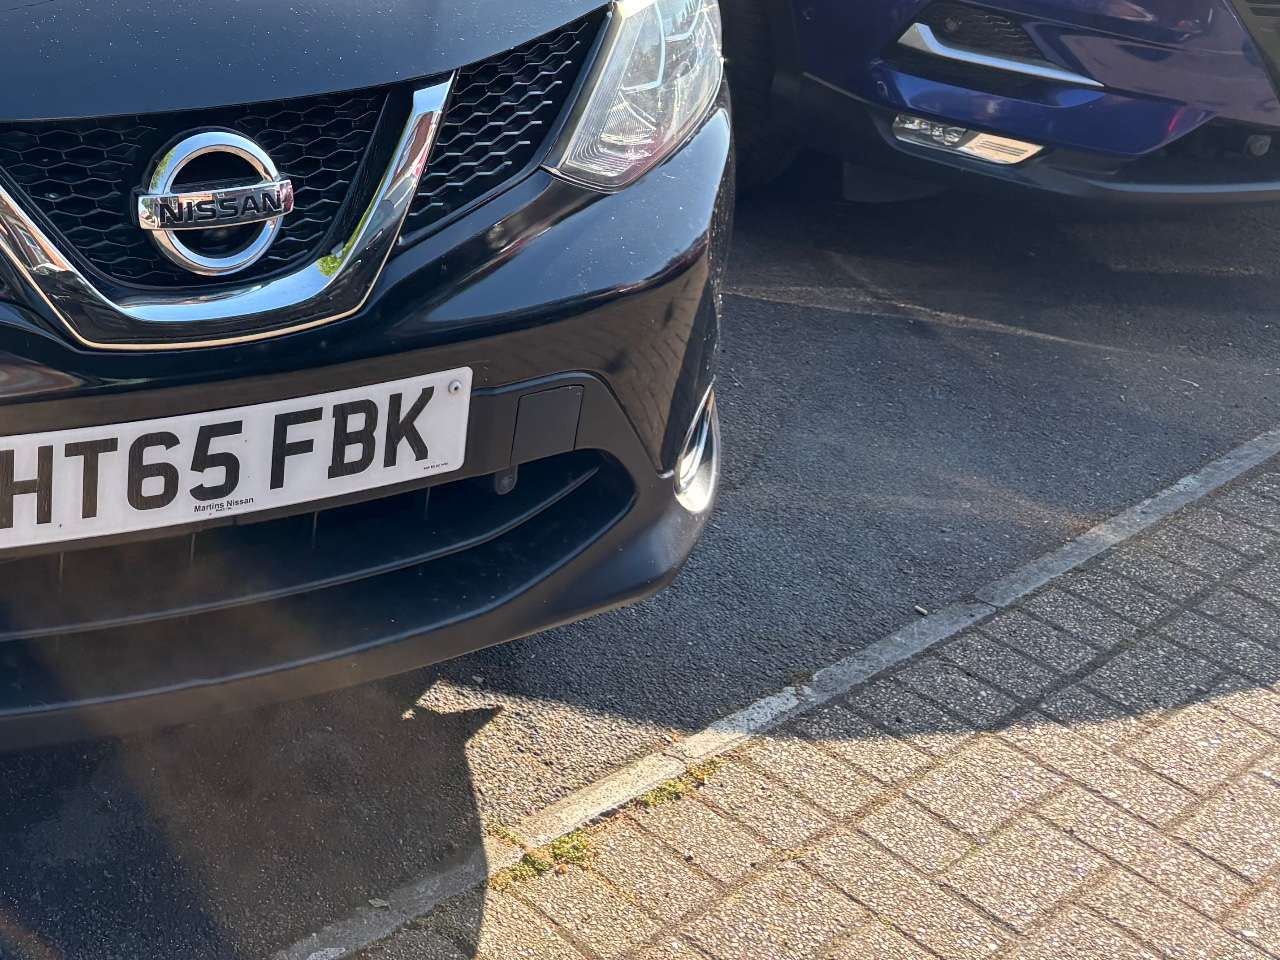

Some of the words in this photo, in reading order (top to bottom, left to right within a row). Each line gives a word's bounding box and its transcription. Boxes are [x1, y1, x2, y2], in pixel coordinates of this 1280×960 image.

[160, 192, 282, 224] NISSAN
[269, 386, 435, 491] FBK
[194, 502, 225, 513] Martins
[226, 497, 254, 508] Nissan
